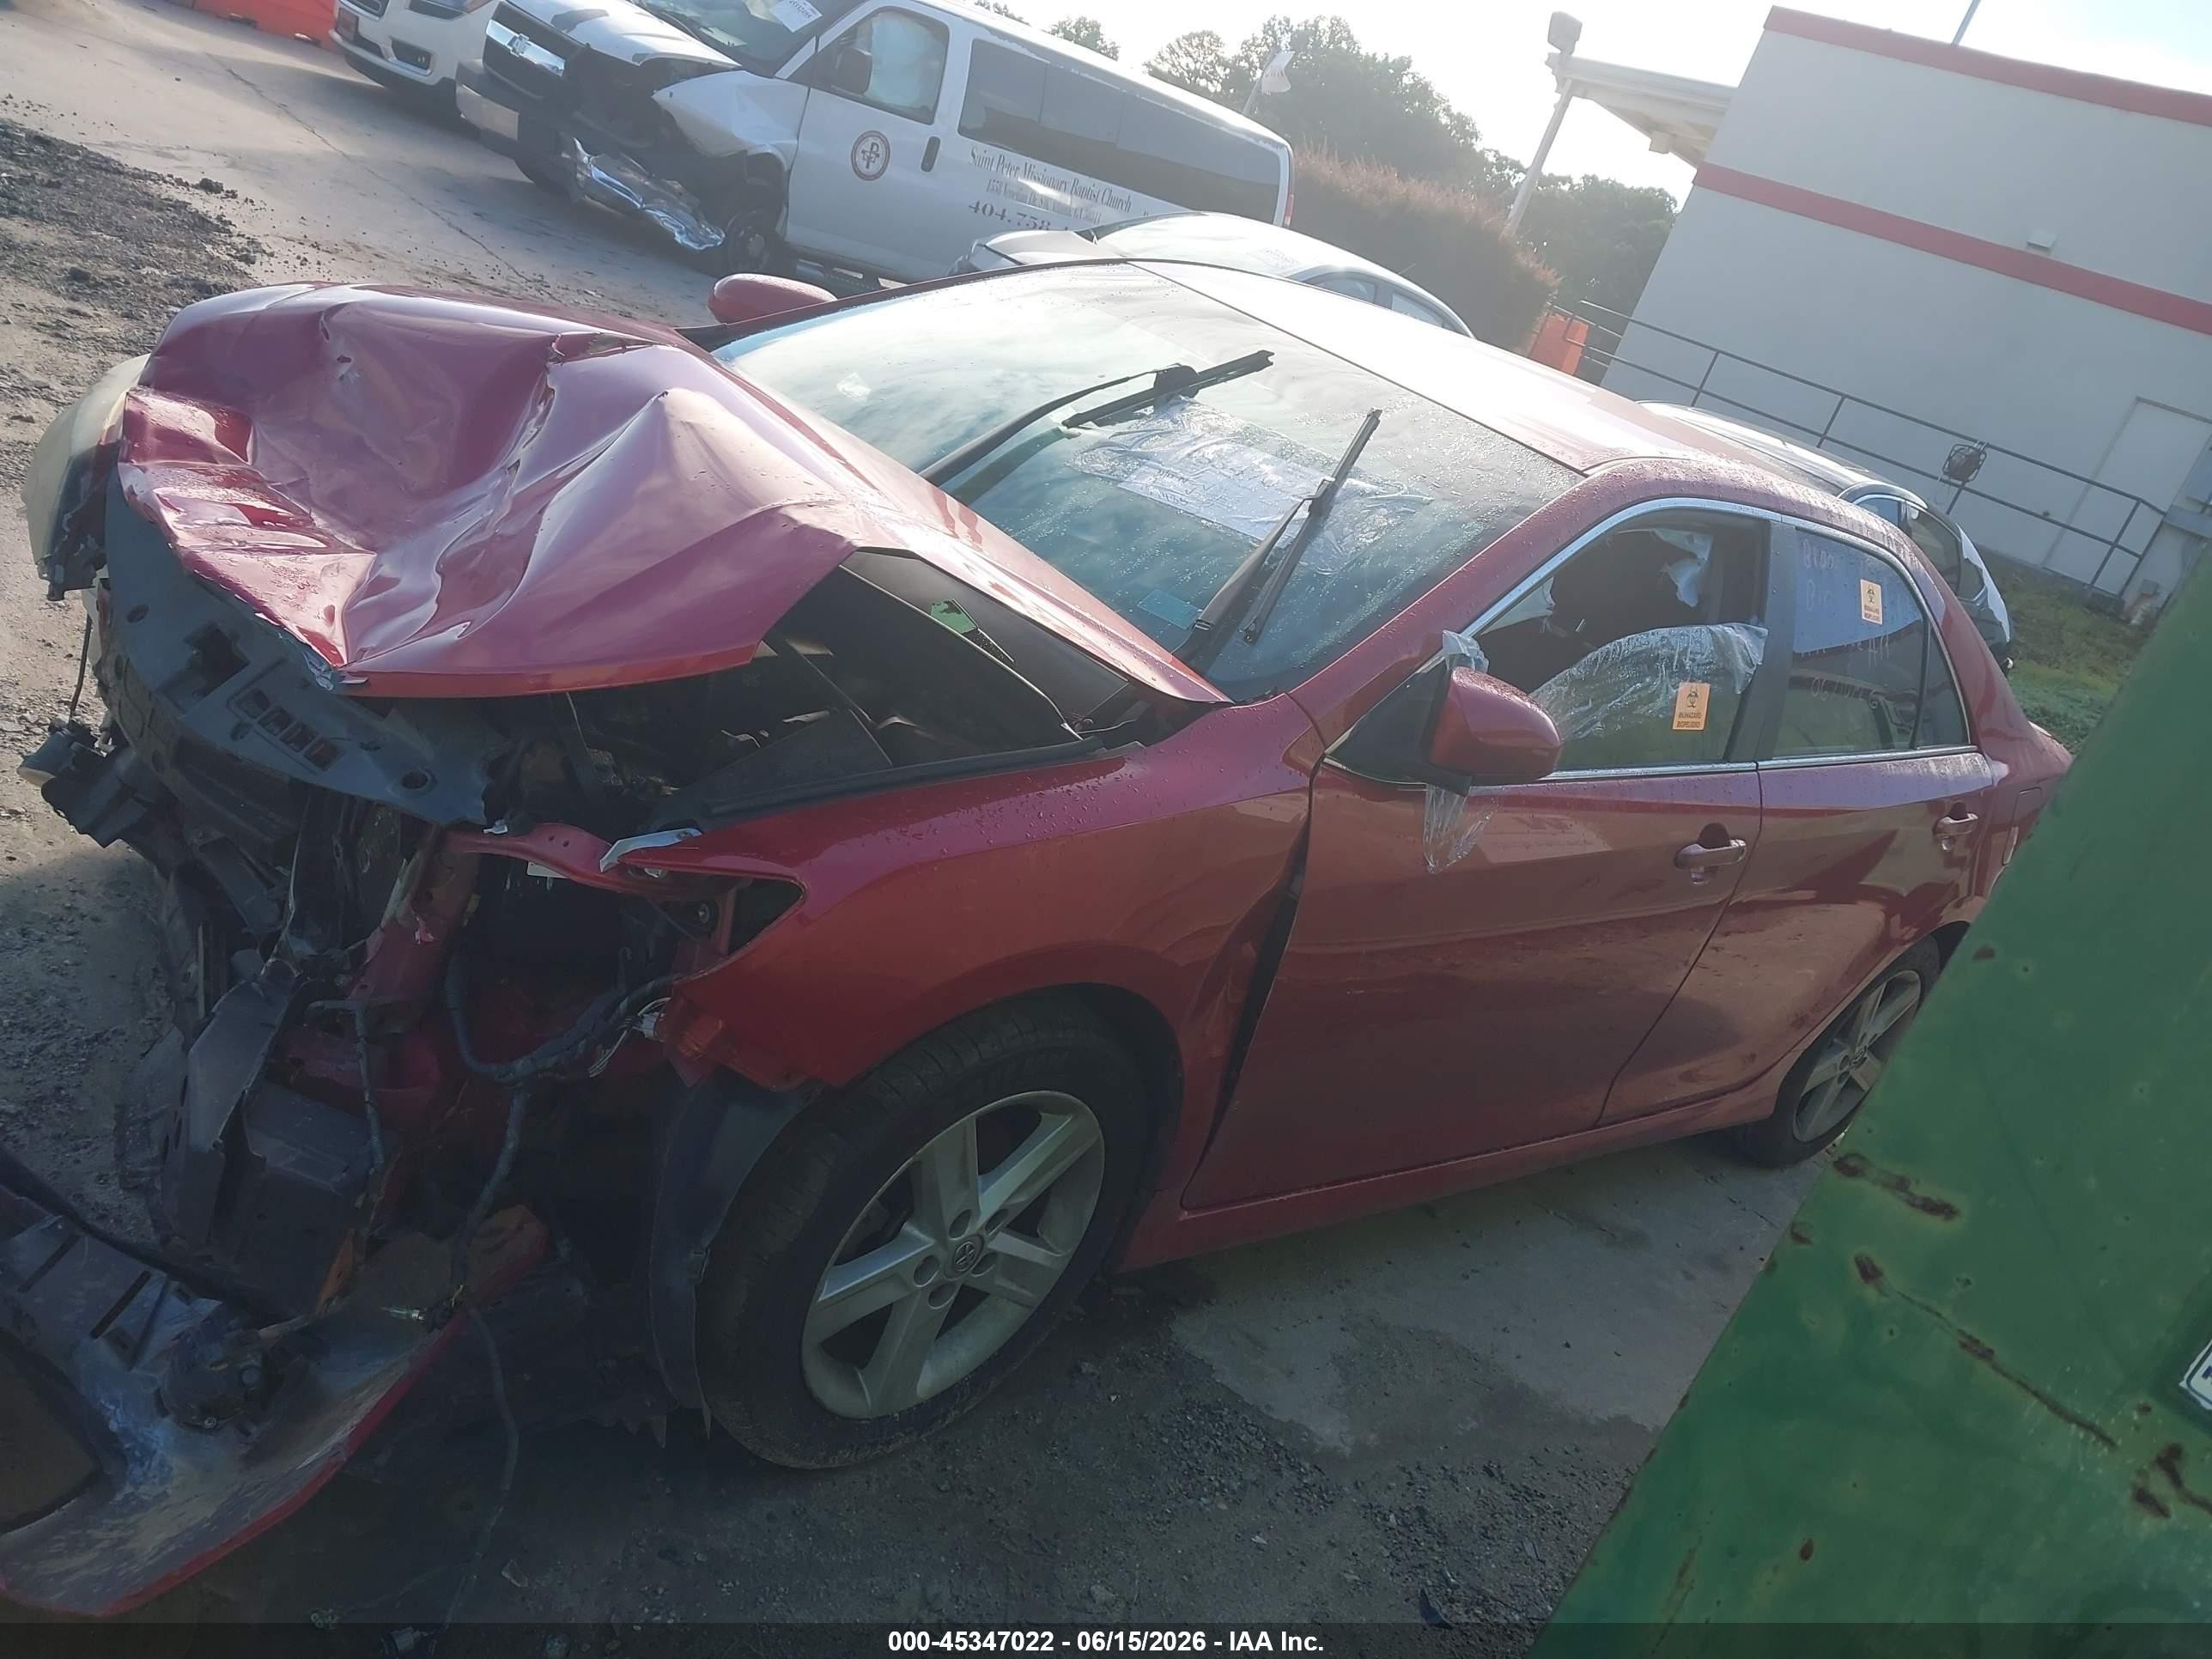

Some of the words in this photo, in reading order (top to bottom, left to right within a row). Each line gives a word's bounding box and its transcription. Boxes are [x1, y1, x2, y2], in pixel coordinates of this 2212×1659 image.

[969, 147, 994, 173] Saint
[997, 155, 1019, 179] Peter
[1023, 161, 1067, 193] Missionary
[1071, 178, 1100, 204] Baptist
[1102, 186, 1132, 213] Church
[968, 200, 1068, 232] 404.758
